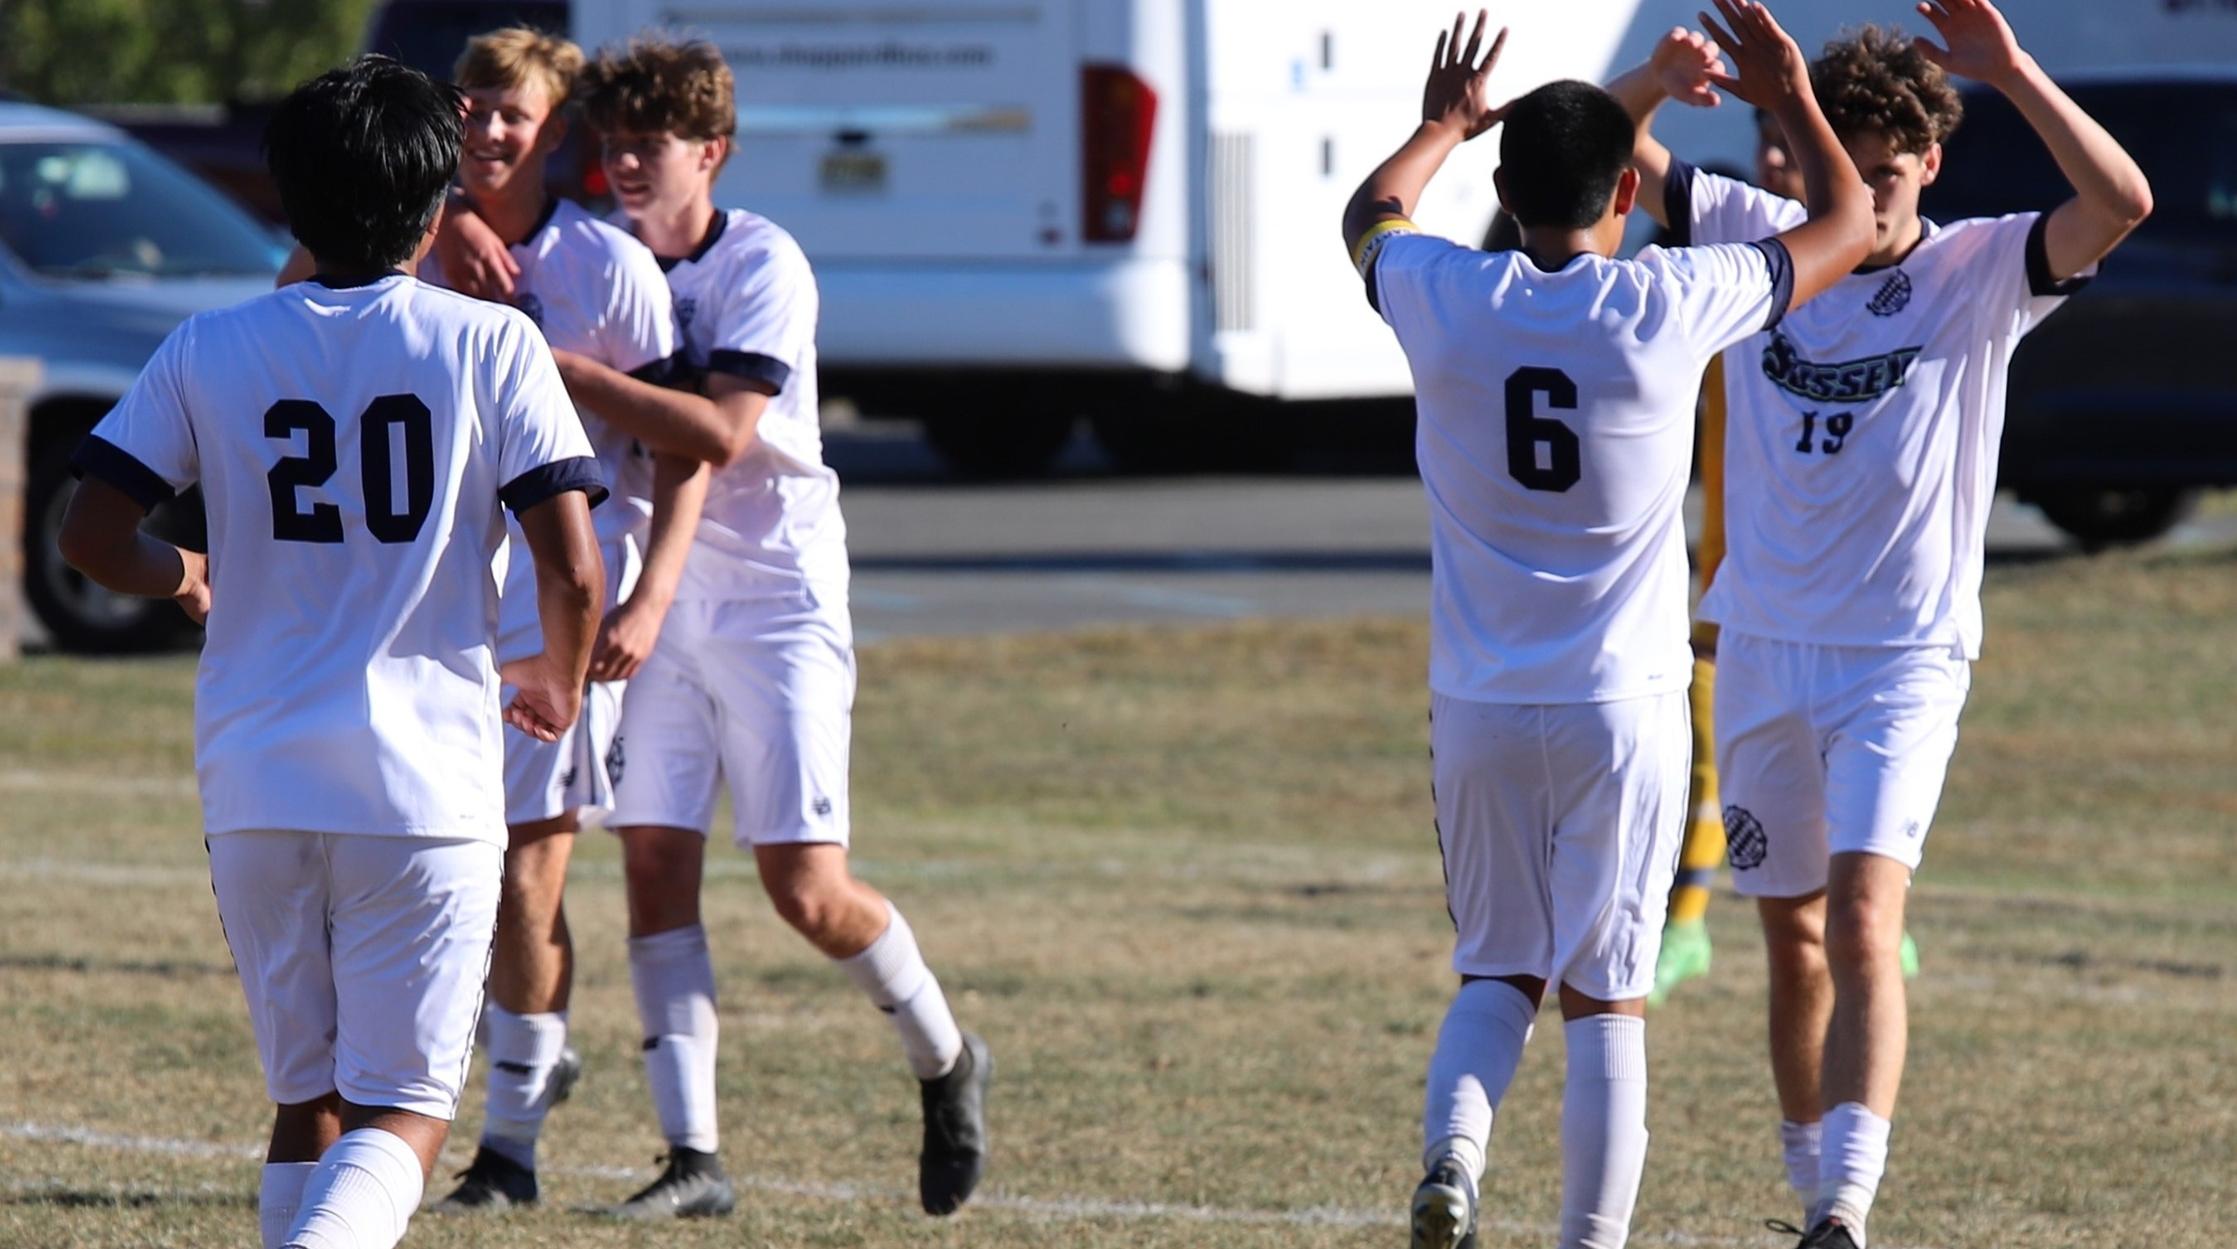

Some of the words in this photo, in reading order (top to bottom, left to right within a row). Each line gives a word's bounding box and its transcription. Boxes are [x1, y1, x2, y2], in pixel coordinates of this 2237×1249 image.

[264, 393, 434, 544] 20
[1505, 366, 1582, 491] 6
[1796, 411, 1854, 454] 19
